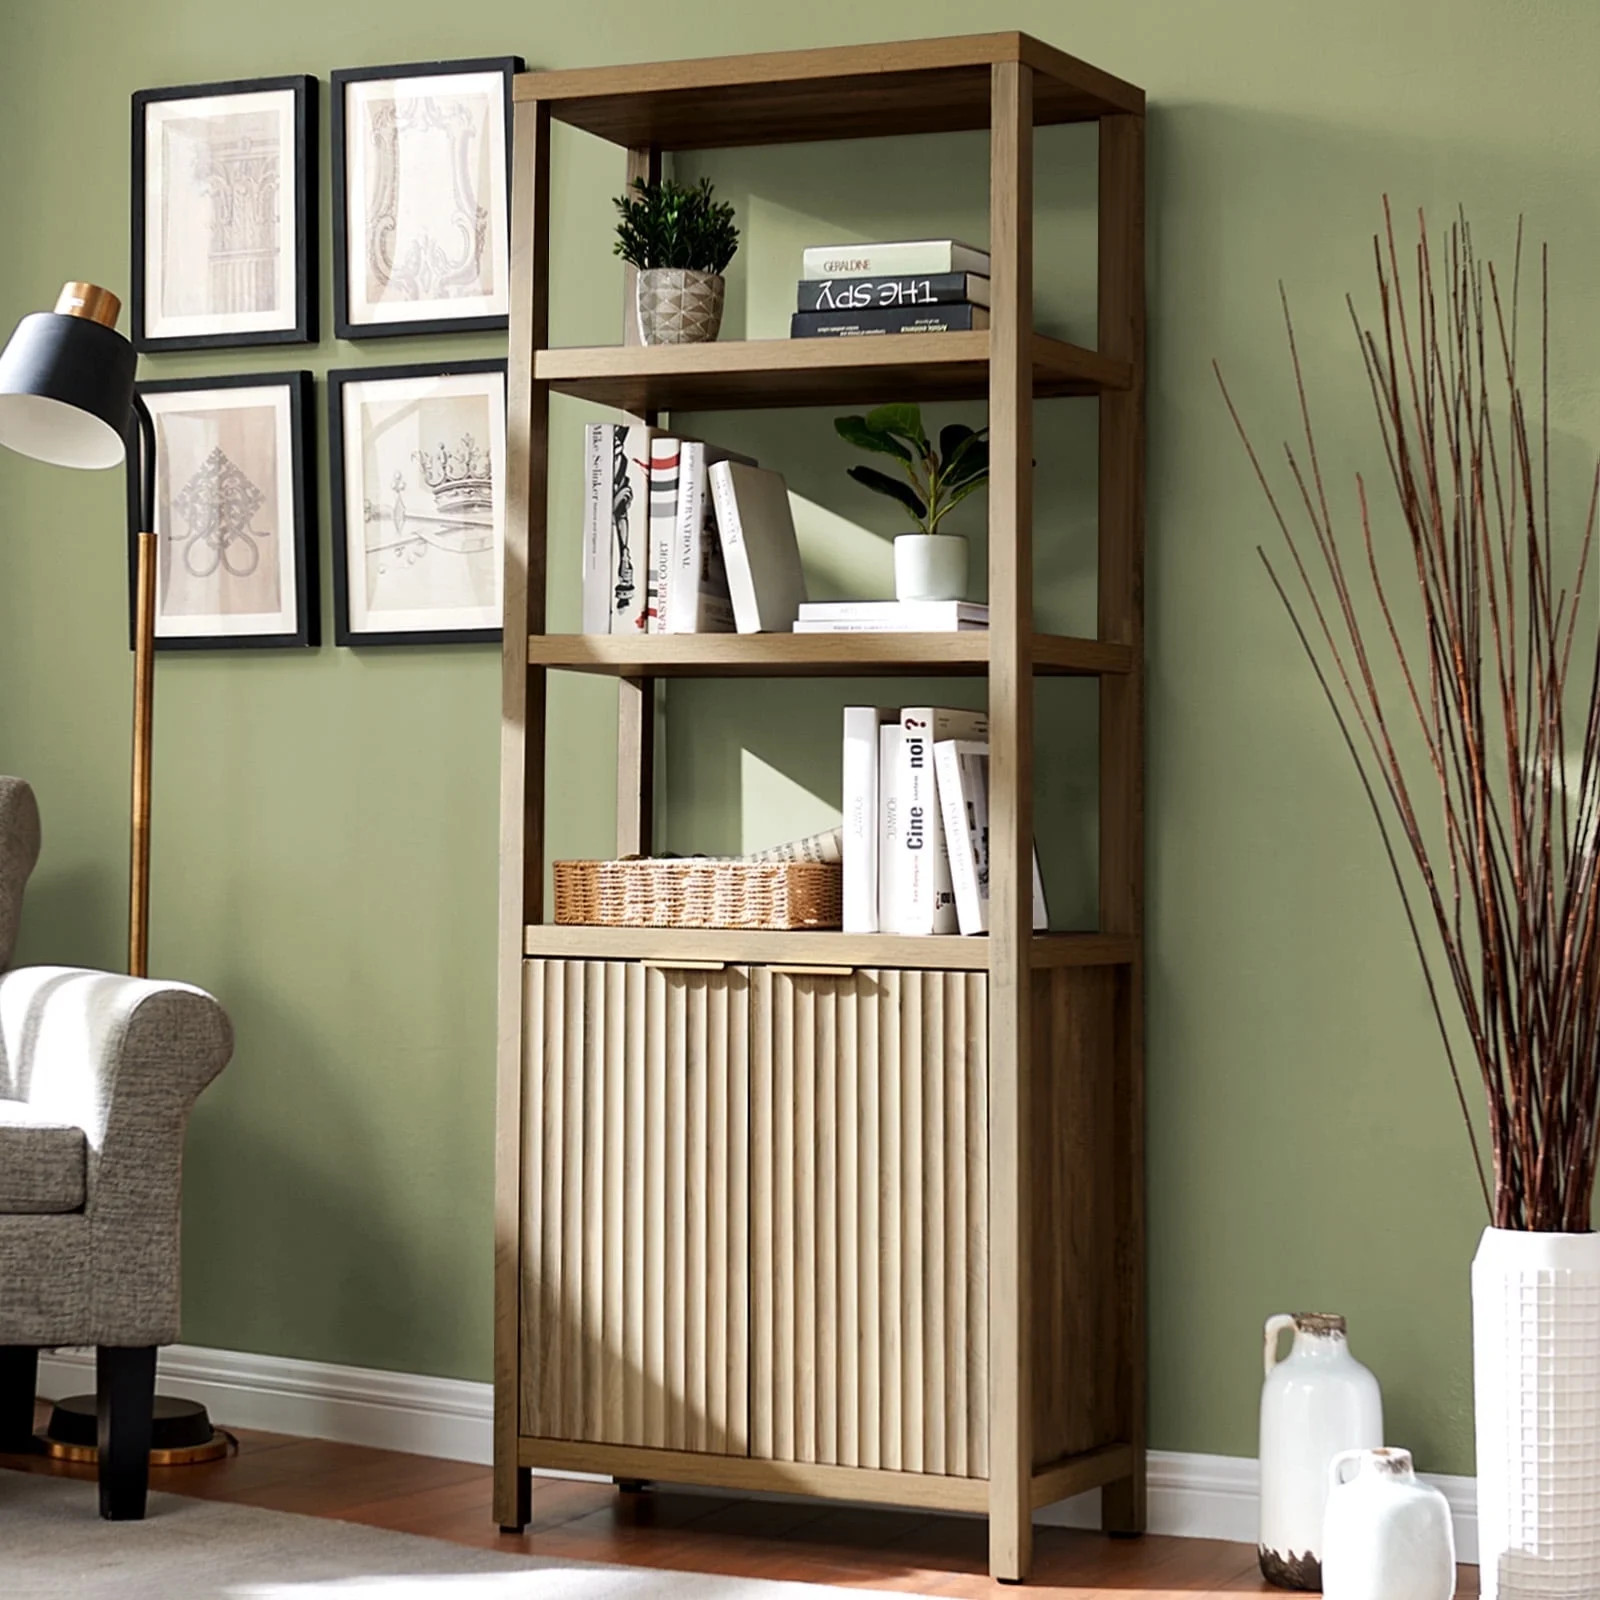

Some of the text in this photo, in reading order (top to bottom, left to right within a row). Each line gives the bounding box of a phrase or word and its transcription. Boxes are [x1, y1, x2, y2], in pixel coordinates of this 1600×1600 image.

[824, 260, 870, 272] GERALDINE
[816, 280, 938, 310] THE SPY
[592, 425, 602, 452] Mike
[592, 455, 602, 500] Selinker
[682, 481, 694, 569] INTERNATIONAL
[659, 541, 669, 580] COURT
[906, 738, 923, 768] noi
[906, 806, 923, 850] Cine
